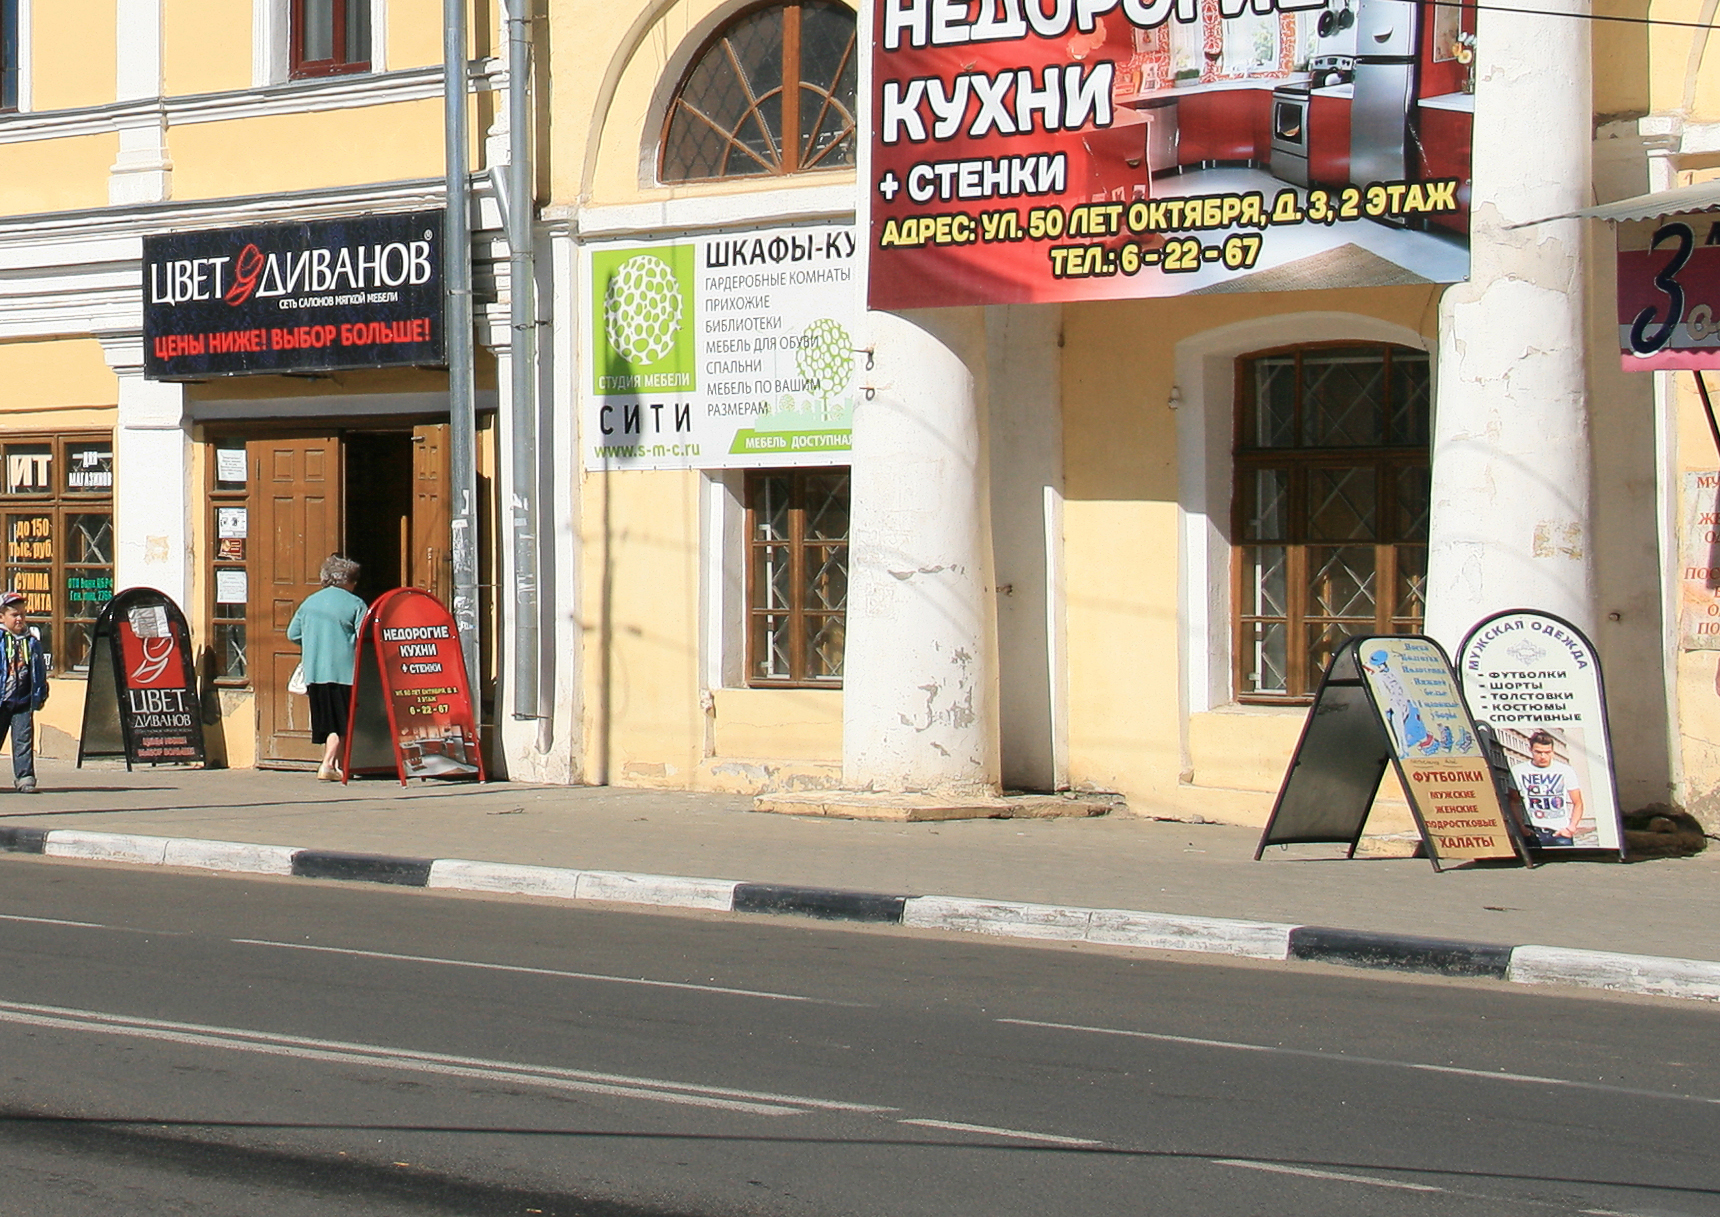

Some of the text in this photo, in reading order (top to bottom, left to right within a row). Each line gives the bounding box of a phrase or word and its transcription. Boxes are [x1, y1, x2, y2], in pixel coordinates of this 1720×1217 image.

[880, 61, 1115, 145] КУХНИ
[907, 153, 1067, 203] СТЕНКИ
[880, 180, 1458, 248] АДРЕС: УЛ. 50 ЛЕТ ОКТЯБРЯ, Д. 3, 2 ЭТАЖ
[151, 241, 431, 306] ЦВЕТ ДИВАНОВ
[706, 268, 851, 292] ГАРДЕРОБНЫЕ КОМНАТЫ
[279, 291, 398, 310] СЕТЬ САЛОНОВ МЯГКОЙ МЕБЕЛИ
[705, 295, 770, 312] ПРИХОЖИЕ
[705, 316, 781, 333] БИБЛИОТЕКИ
[154, 318, 431, 361] ЦЕНЫ НИЖЕ! ВЫБОР БОЛЬШЕ!
[706, 336, 819, 354] МЕБЕЛЬ ДЛЯ ОБУВИ
[706, 360, 762, 375] СПАЛЬНИ
[598, 372, 690, 390] СТУДИЯ МЕБЕЛИ
[707, 378, 821, 396] МЕБЕЛЬ ПО ВАШИМ
[707, 402, 768, 417] РАЗМЕРАМ
[600, 403, 691, 434] СИТИ
[745, 436, 787, 449] МЕБЕЛЬ
[594, 443, 700, 459] www.s-m-c.ru
[16, 517, 50, 539] до 150
[15, 571, 49, 591] СУММА
[383, 626, 449, 641] НЕДОРОГИЕ
[400, 644, 437, 657] КУХНИ
[1468, 620, 1588, 671] МУЖСКАЯ ОДЕЖДА
[409, 663, 442, 674] СТЕНКИ
[1488, 671, 1567, 679] ФУТБОЛКИ
[1490, 681, 1543, 689] ШОРТЫ
[130, 689, 186, 715] ЦВЕТ
[1490, 692, 1574, 700] ТОЛСТОВКИ
[1492, 703, 1566, 711] КОСТЮМЫ
[134, 714, 192, 729] ДИВАНОВ
[1490, 714, 1582, 722] СПОРТИВНЫЕ
[1413, 770, 1484, 783] ФУТБОЛКИ
[1430, 790, 1476, 799] МУЖСКИЕ
[1435, 805, 1478, 814] ЖЕНСКИЕ
[1425, 819, 1498, 830] ПОДРОСТКОВЫЕ
[1439, 836, 1495, 848] ХАЛАТЫ
